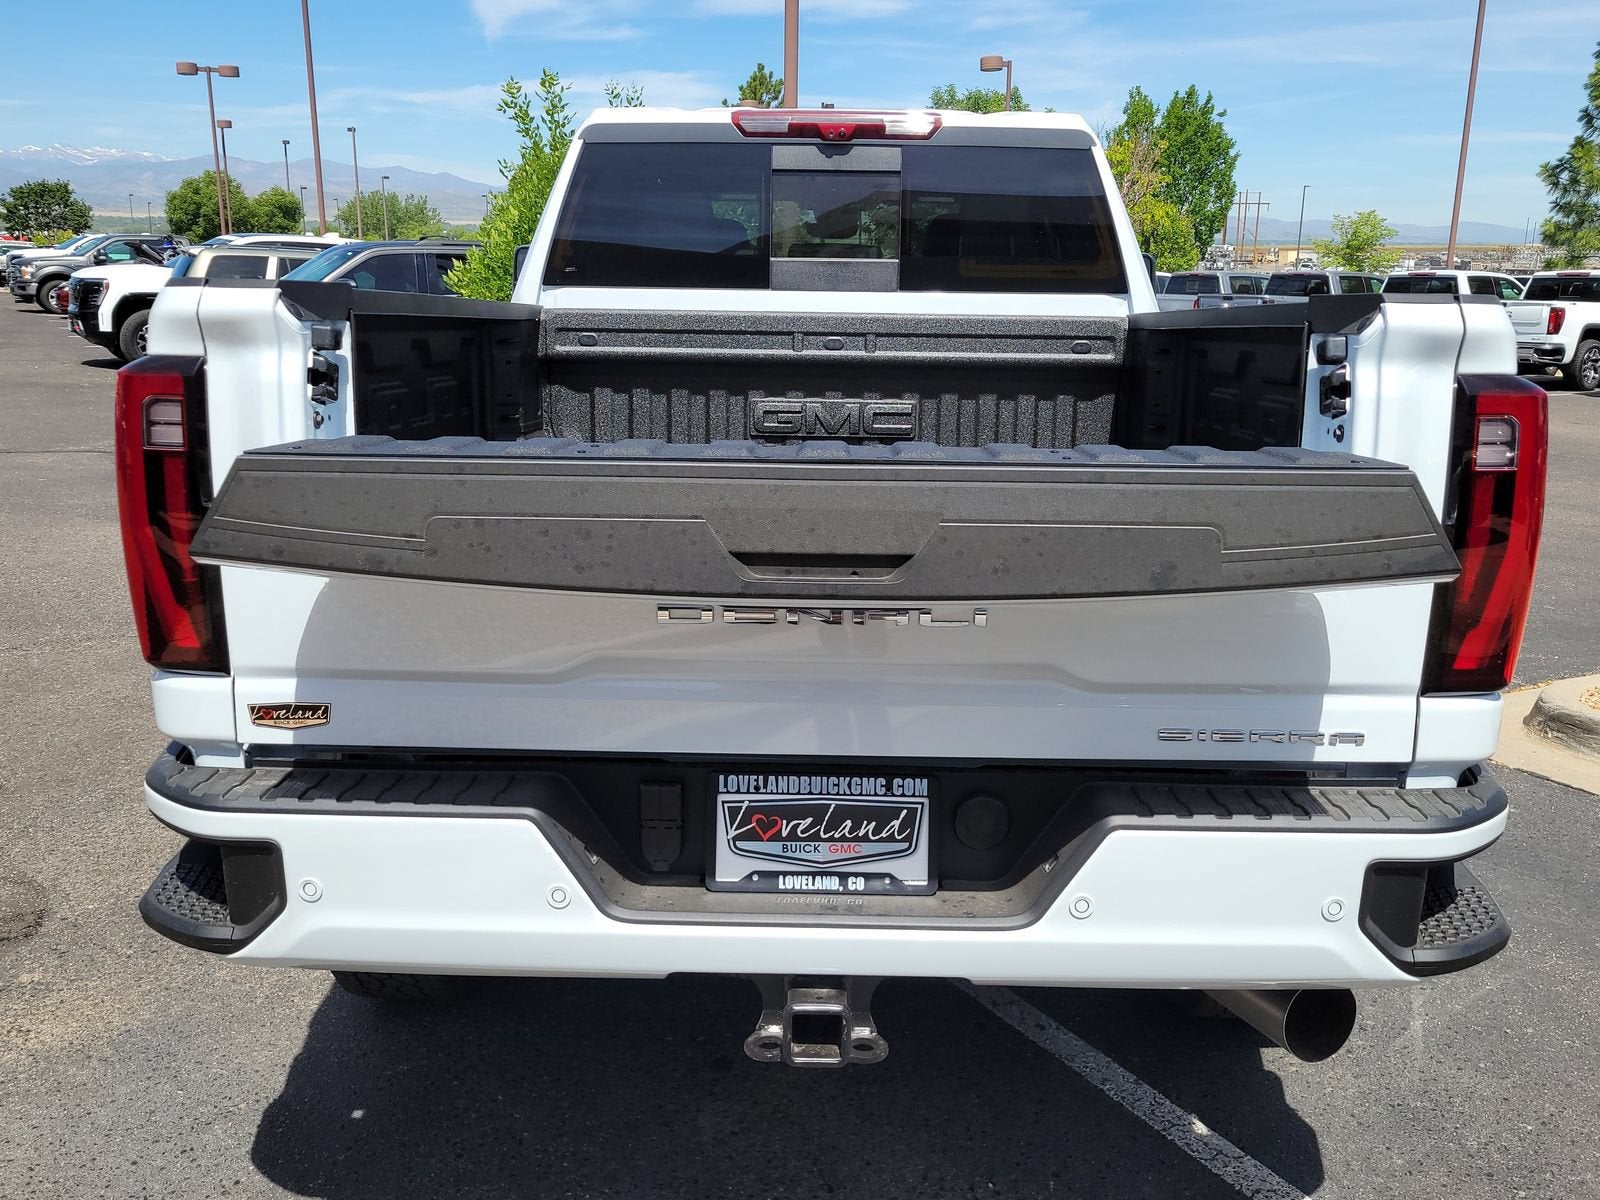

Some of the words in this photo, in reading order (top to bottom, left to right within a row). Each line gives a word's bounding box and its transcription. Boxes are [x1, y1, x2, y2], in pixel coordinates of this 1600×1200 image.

[753, 402, 913, 435] GMC
[657, 603, 987, 627] DENALI
[252, 703, 327, 720] Loveland
[1158, 728, 1365, 746] SIERRA
[718, 775, 928, 796] LOVELANDBUICKGMC.COM
[727, 800, 911, 841] Loveland
[782, 843, 822, 854] BUICK
[828, 843, 863, 855] GMC
[778, 875, 844, 892] LOVELAND,
[847, 876, 865, 891] CO
